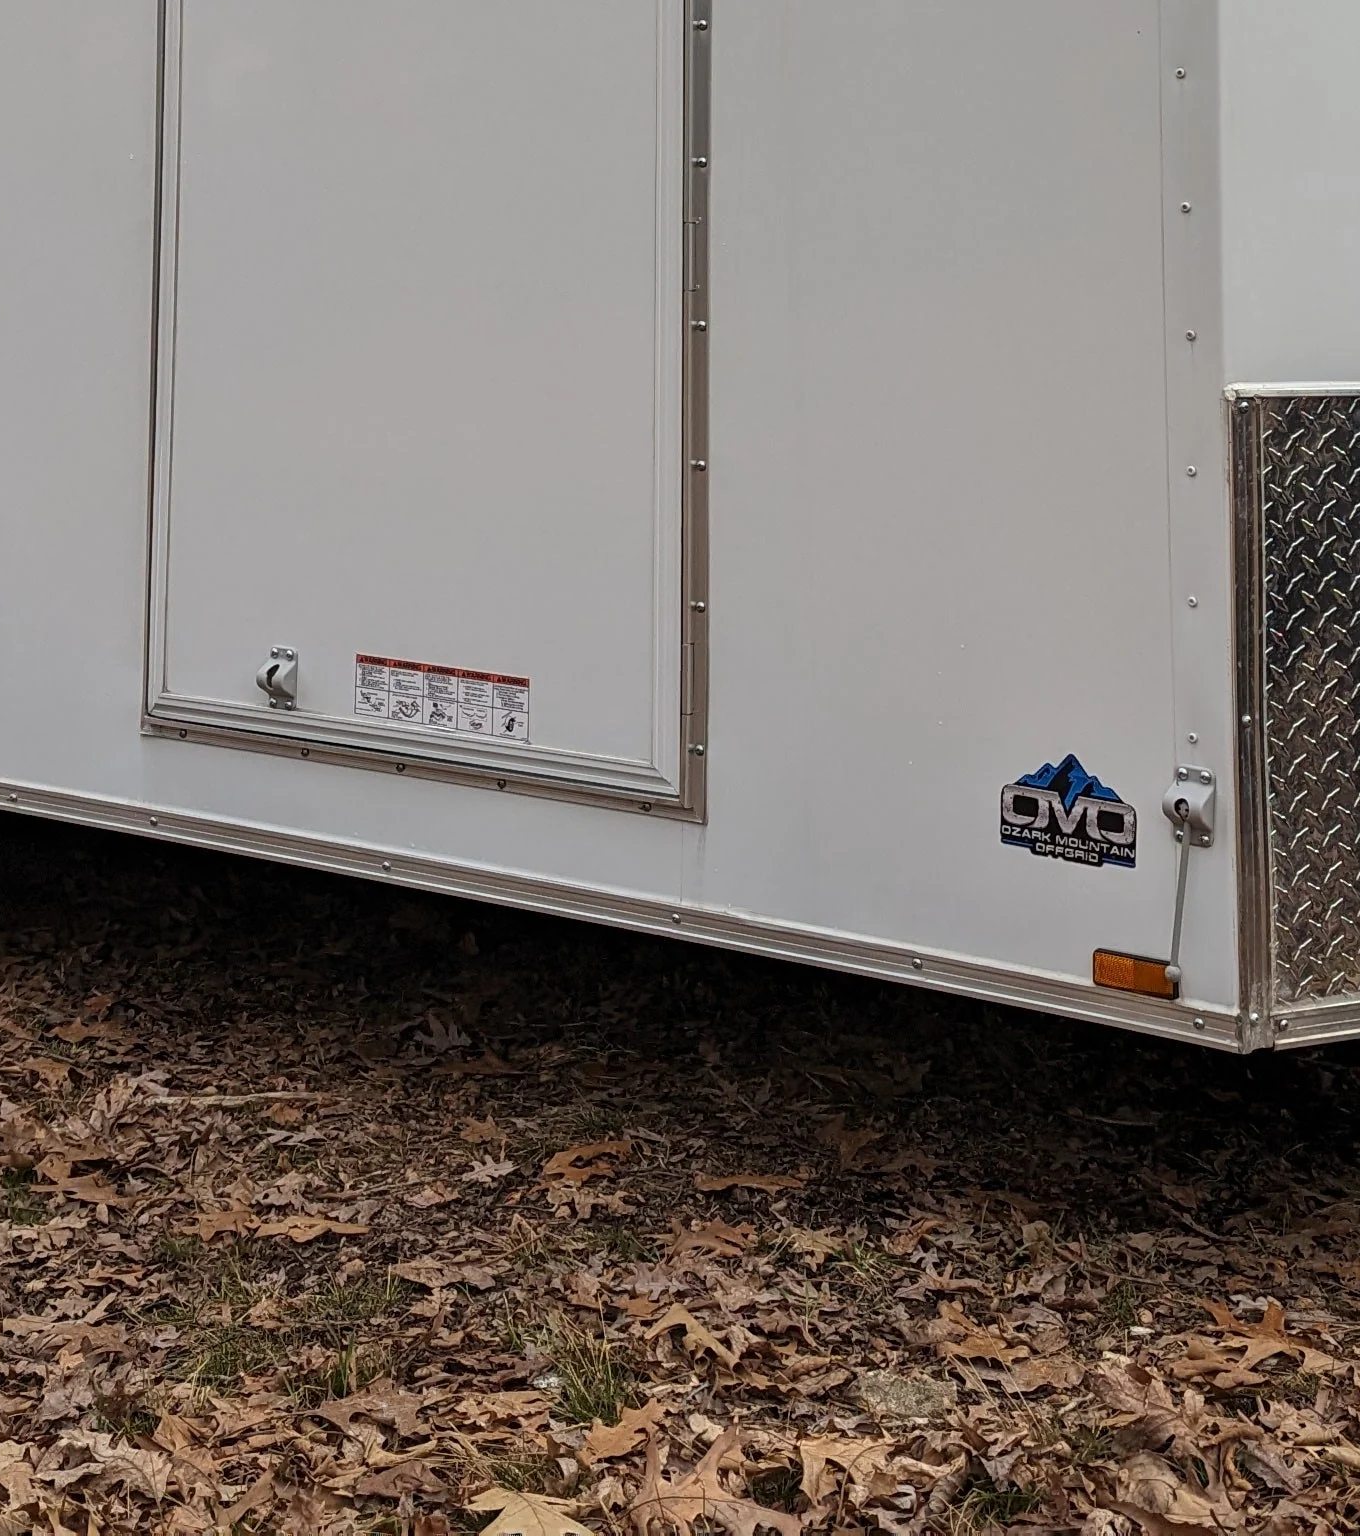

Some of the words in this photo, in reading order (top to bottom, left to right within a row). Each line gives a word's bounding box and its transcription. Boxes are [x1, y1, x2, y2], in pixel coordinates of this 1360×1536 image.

[1001, 825, 1052, 842] OZARK
[1055, 835, 1135, 858] MOUNTAIN
[1035, 843, 1099, 863] OFFGRID
